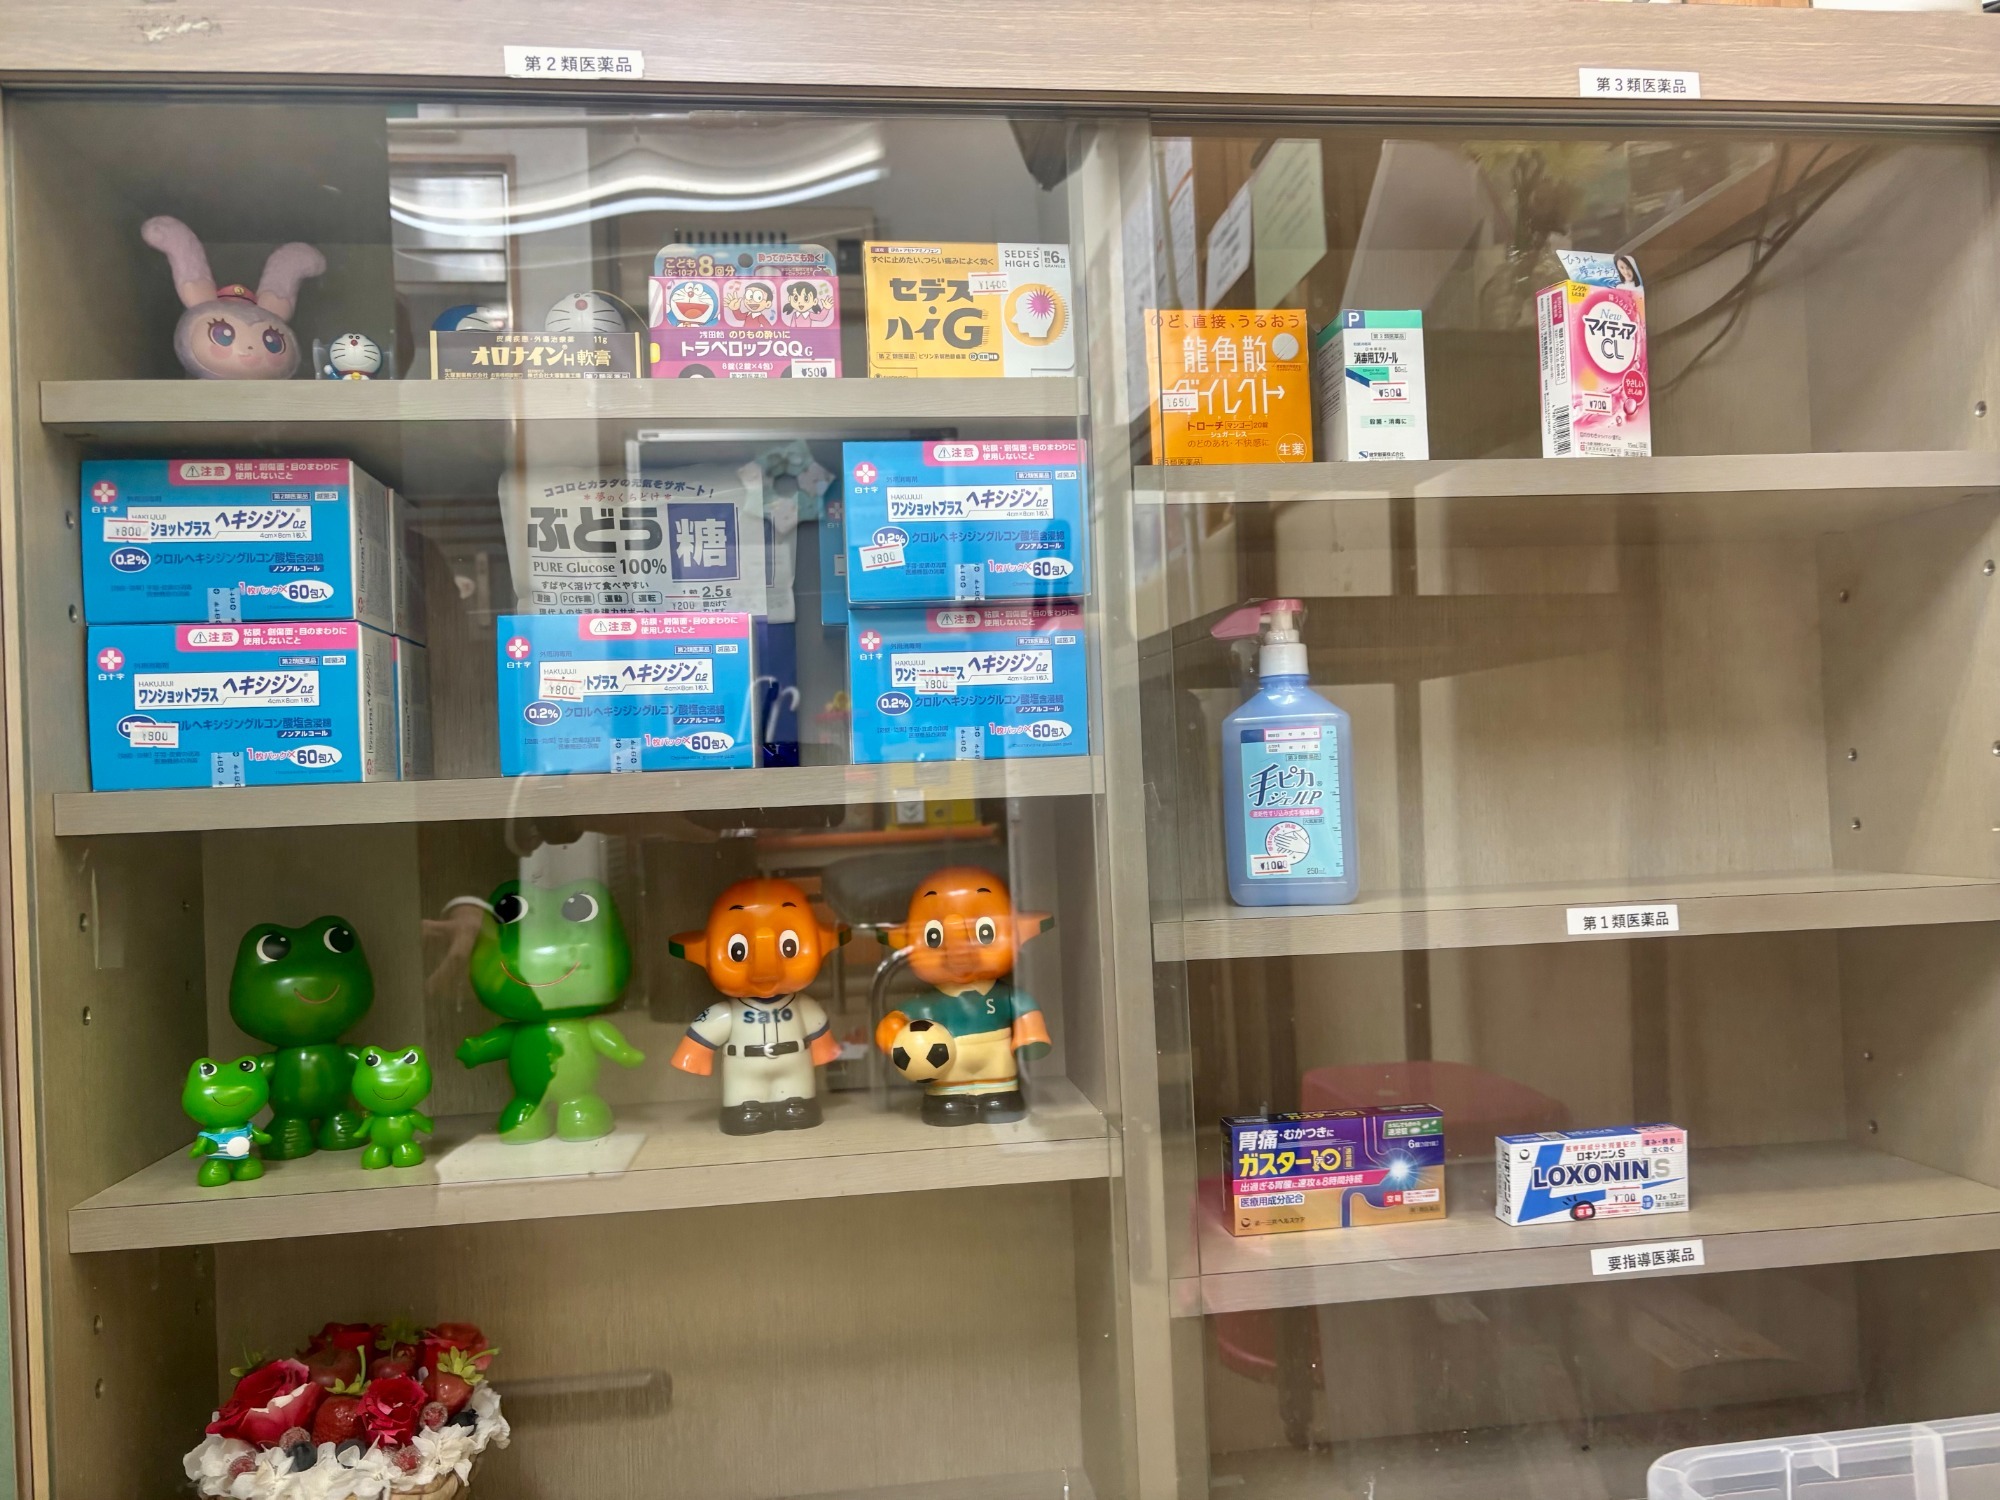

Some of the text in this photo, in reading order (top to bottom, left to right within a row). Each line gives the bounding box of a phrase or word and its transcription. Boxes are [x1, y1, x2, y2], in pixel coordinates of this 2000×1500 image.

[524, 55, 633, 73] 第2類医薬品
[1596, 77, 1687, 94] 第3類医薬品
[870, 256, 995, 266] すぐに止めたい、つらい痛みによく効く
[1004, 250, 1039, 259] SEDES
[665, 259, 697, 268] こども
[1005, 260, 1040, 268] HIGH G
[889, 278, 974, 303] セデス
[1150, 313, 1301, 330] のど、直接、うるおう
[1348, 312, 1360, 328] P
[1600, 309, 1622, 321] New
[885, 306, 986, 349] ハイG
[1584, 317, 1636, 341] マイティア
[729, 331, 791, 339] のりもの酔いに
[680, 340, 814, 358] トラベロップQQG
[1182, 335, 1268, 373] 龍角散
[1600, 338, 1625, 360] CL
[471, 346, 612, 367] オロナインH軟膏
[1353, 351, 1399, 365] 消毒用エタノール
[1187, 421, 1224, 431] トローチ
[951, 447, 975, 458] 注意
[982, 452, 1036, 460] 使用しないこと
[1278, 442, 1305, 457] 生薬
[199, 466, 225, 477] 注意
[234, 472, 294, 480] 使用しないこと
[543, 478, 714, 499] ココロとカラダの元気をサポート!
[854, 486, 879, 494] 白十字
[91, 506, 119, 514] 白十字
[890, 489, 1049, 517] ワンショットプラス ヘキシジン 0.2
[150, 509, 307, 537] ショットプラス ヘキシジン 0.2
[527, 506, 728, 568] ぶどう 糖
[876, 533, 906, 544] 0.2%
[115, 554, 148, 565] 0.2%
[870, 551, 897, 564] ¥800
[533, 558, 668, 576] PURE Glucose 100%
[540, 580, 650, 591] すばやく溶けて食べやすい
[701, 585, 733, 599] 2.5g
[562, 593, 593, 604] PC作業
[604, 593, 623, 603] 運動
[953, 614, 977, 624] 注意
[984, 618, 1036, 627] 使用しないこと
[608, 621, 632, 632] 注意
[641, 625, 696, 634] 使用しないこと
[208, 631, 234, 643] 注意
[243, 636, 302, 645] 使用しないこと
[506, 661, 532, 669] 白十字
[967, 654, 1049, 674] ヘキシジン 0.2
[98, 672, 126, 681] 白十字
[621, 661, 709, 682] ヘキシジン 0.2
[138, 680, 175, 688] HAKUJUJI
[138, 673, 314, 704] ワンショットプラス ヘキシジン 0.2
[549, 685, 576, 696] ¥800
[880, 699, 909, 709] 0.2%
[528, 708, 559, 719] 0.2%
[676, 716, 723, 724] ノンアルコール
[164, 716, 332, 732] ルヘキシジングルコン酸塩含浸綿
[280, 729, 329, 737] ノンアルコール
[1248, 763, 1316, 807] 手ピカ
[1267, 790, 1324, 807] ジェルP
[1582, 911, 1670, 931] 第1類医薬品
[986, 998, 996, 1016] S
[743, 1007, 794, 1025] sato
[1238, 1127, 1335, 1152] 胃痛・むかつきに
[1577, 1148, 1626, 1162] ロキソニンS
[1238, 1147, 1342, 1178] ガスター10
[1532, 1159, 1650, 1189] LOXONIN
[1654, 1158, 1671, 1178] S
[1240, 1193, 1304, 1208] 医療用成分配合
[1607, 1247, 1696, 1271] 要指導医薬品
